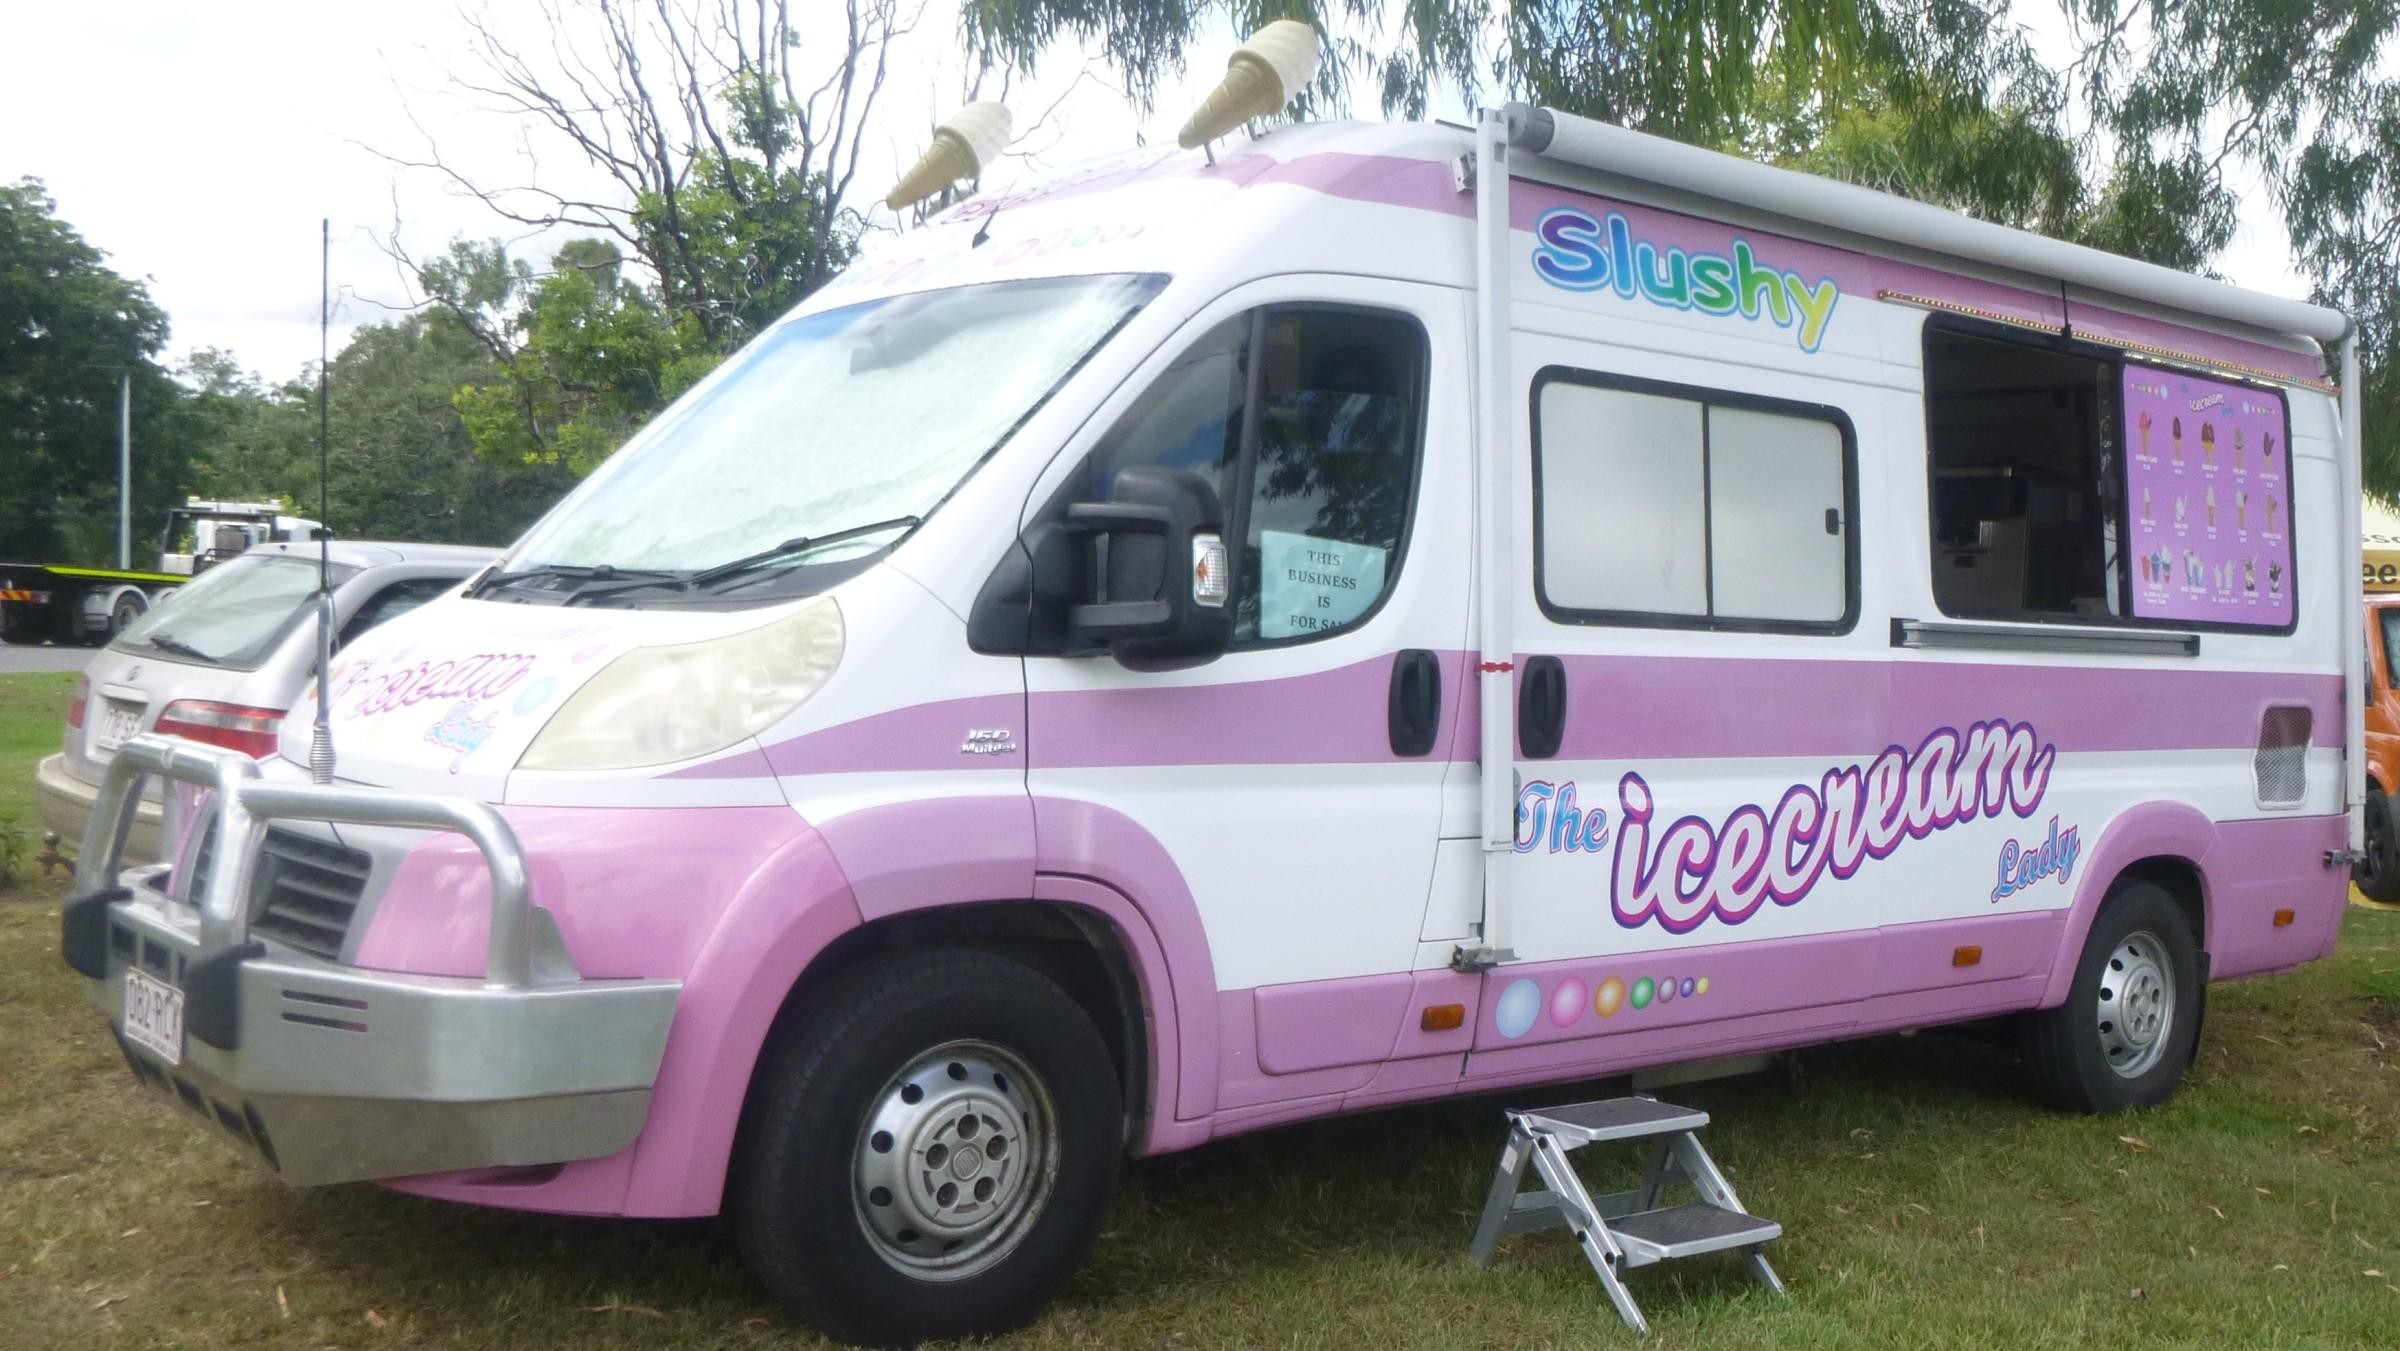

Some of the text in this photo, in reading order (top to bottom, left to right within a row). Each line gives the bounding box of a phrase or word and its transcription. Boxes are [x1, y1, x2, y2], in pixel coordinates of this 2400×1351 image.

[1532, 205, 1840, 353] Slushy
[1307, 550, 1340, 566] THIS
[1288, 569, 1357, 590] BUSINESS
[1317, 596, 1330, 609] IS
[1290, 615, 1343, 632] FOR SA
[1513, 717, 2057, 935] The icecream
[1990, 814, 2081, 903] Lady
